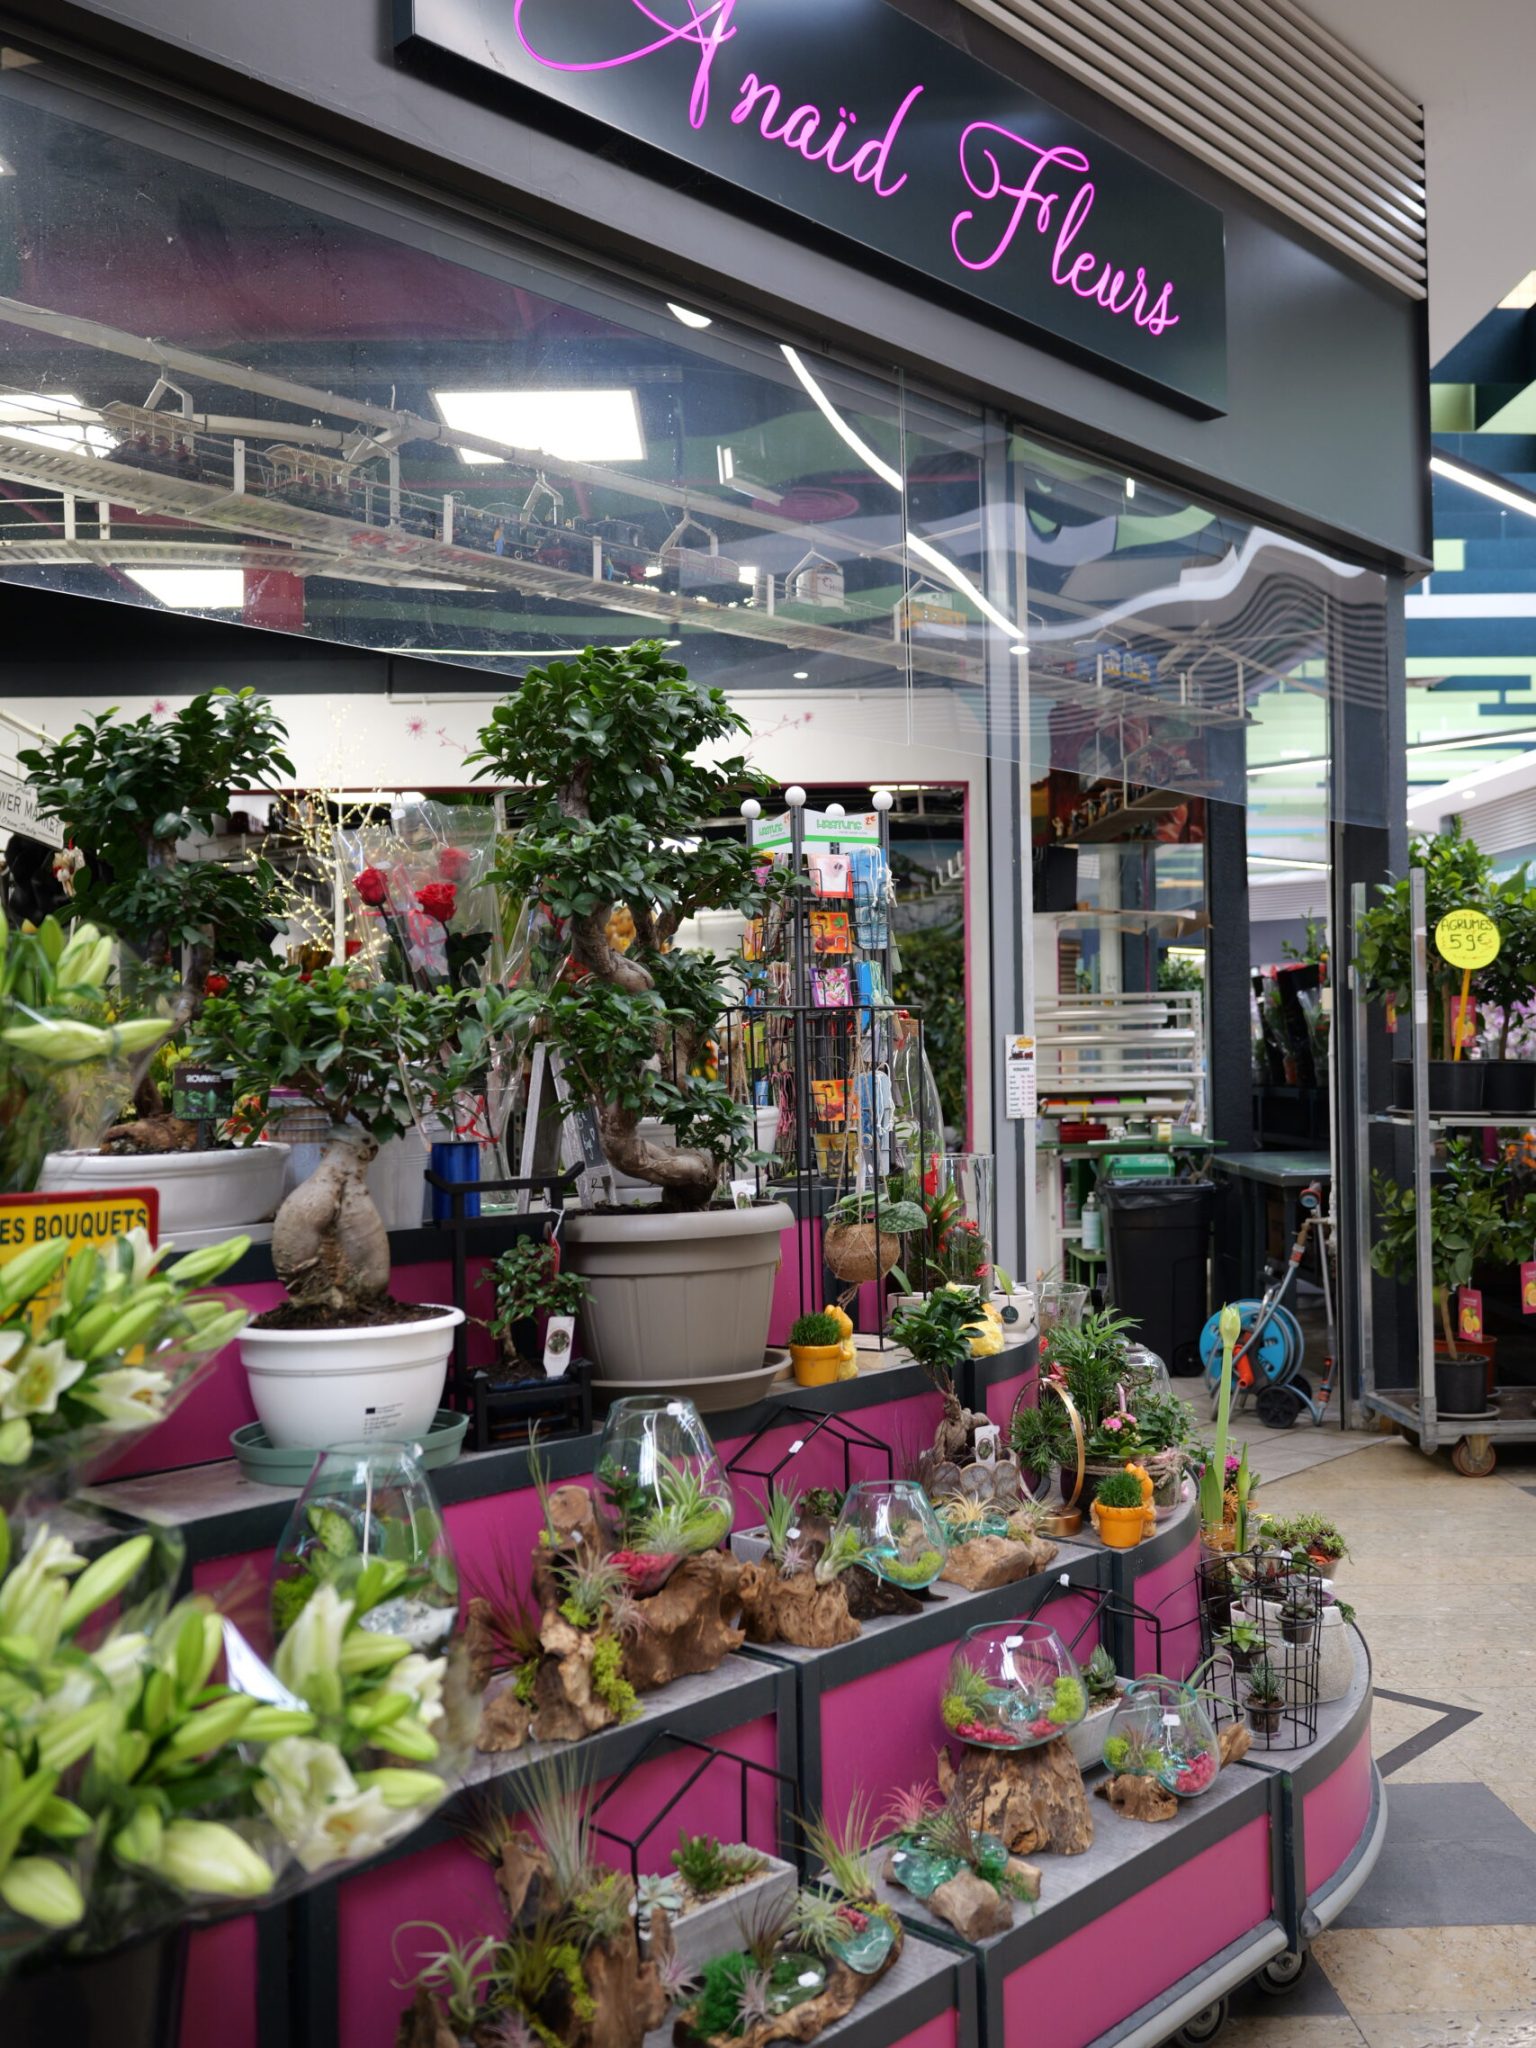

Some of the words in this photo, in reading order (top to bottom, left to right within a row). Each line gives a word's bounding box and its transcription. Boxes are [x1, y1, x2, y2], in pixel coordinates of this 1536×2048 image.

[950, 121, 1180, 336] Fleurs
[1440, 918, 1494, 932] AGRUMES
[33, 1207, 148, 1242] BOUQUETS
